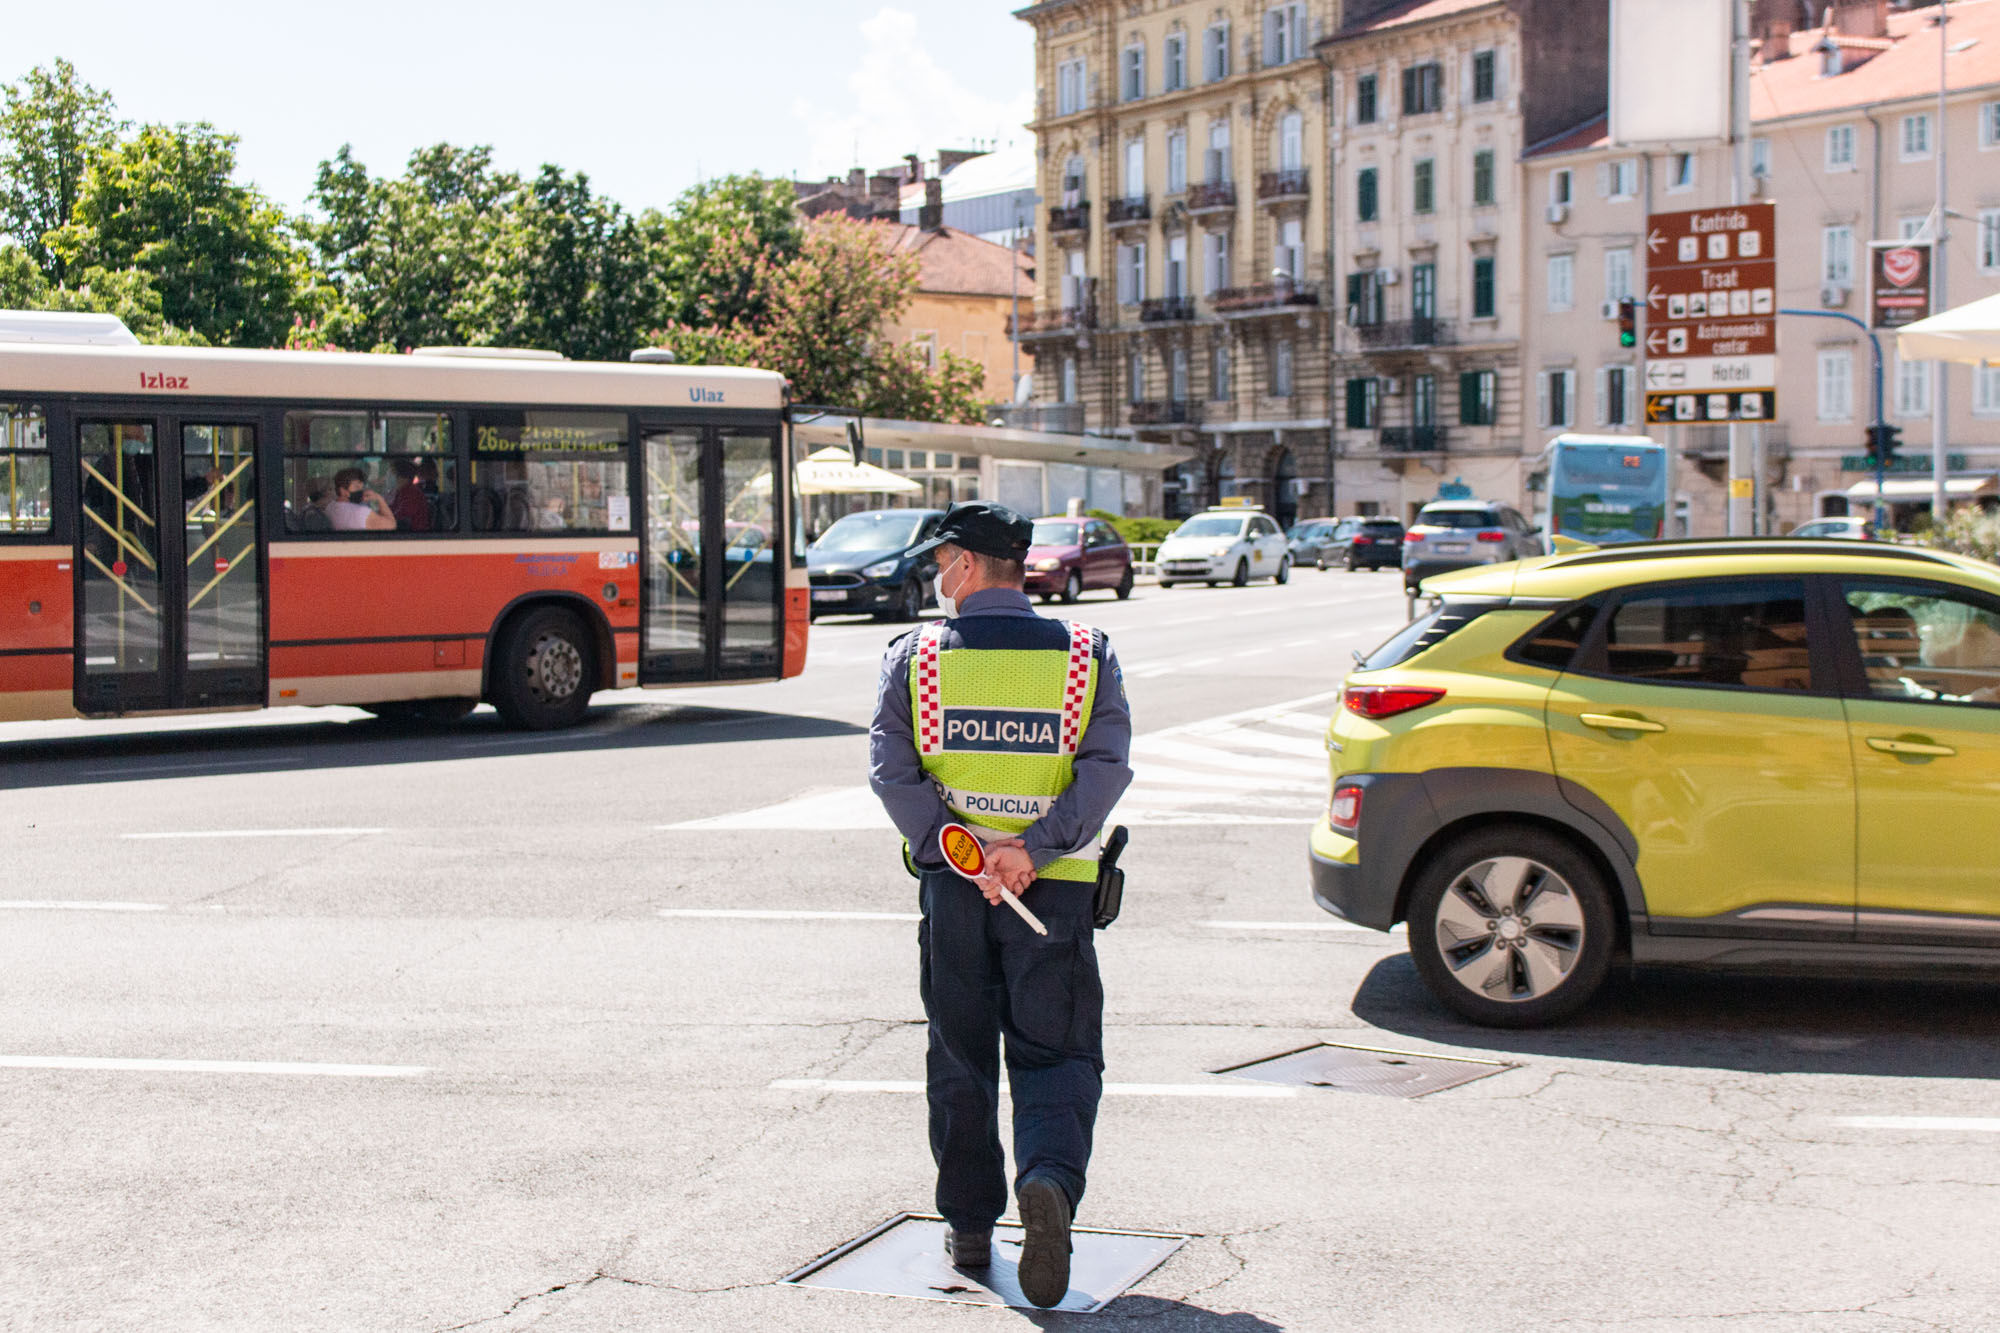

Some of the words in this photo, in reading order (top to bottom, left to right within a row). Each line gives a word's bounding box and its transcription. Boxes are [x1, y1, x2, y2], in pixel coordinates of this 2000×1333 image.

[1690, 210, 1748, 233] Kantrida
[1701, 267, 1739, 289] Trsat
[1696, 322, 1768, 339] Astronomski
[1712, 339, 1749, 355] centar
[140, 371, 189, 389] Izlaz
[1712, 362, 1750, 381] Hoteli
[689, 387, 725, 402] Ulaz
[478, 426, 498, 451] 26
[947, 719, 1055, 744] POLICIJA
[966, 795, 1040, 815] POLICIJA
[951, 834, 966, 860] STOP
